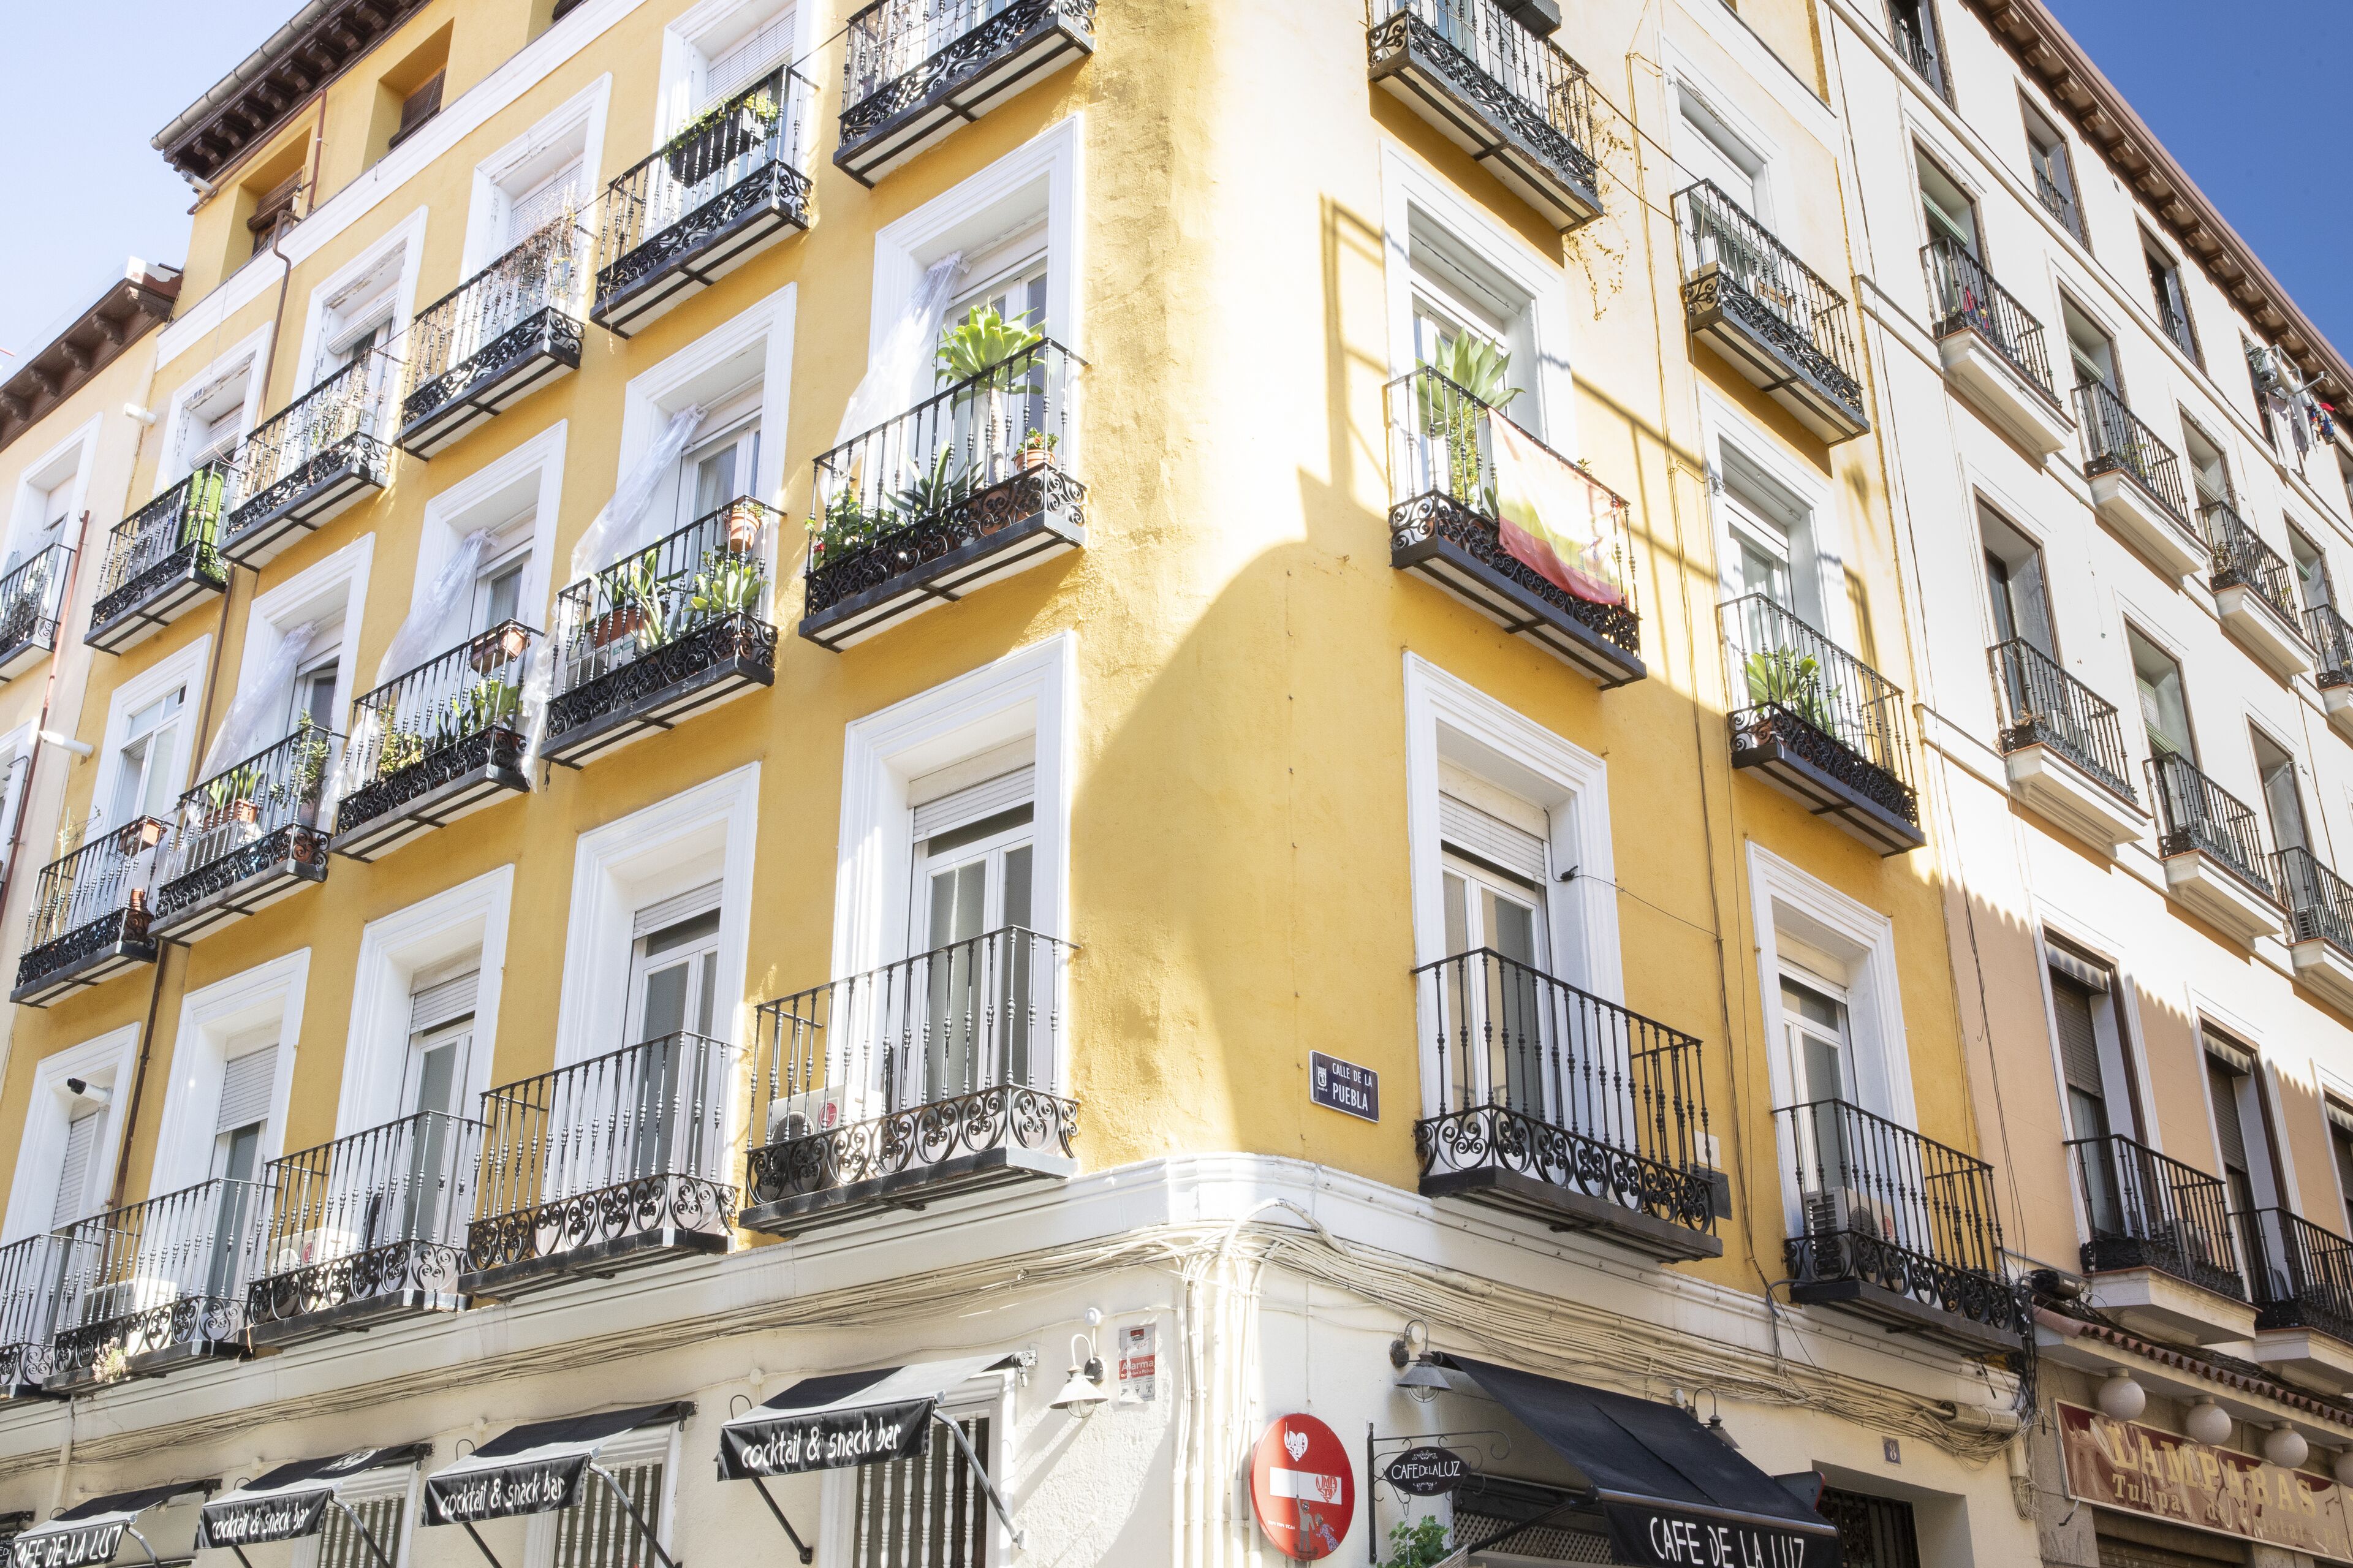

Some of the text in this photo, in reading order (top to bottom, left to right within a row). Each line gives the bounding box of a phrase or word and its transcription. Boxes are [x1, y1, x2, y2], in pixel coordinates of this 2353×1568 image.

[1333, 1062, 1373, 1088] CALLE DE LA
[1333, 1082, 1368, 1112] PUEBLA
[742, 1417, 901, 1468] cocktail & snack bar
[1890, 1442, 1897, 1461] 8
[1392, 1464, 1419, 1479] CAFE
[1428, 1464, 1438, 1475] LA
[1438, 1461, 1460, 1477] LUZ
[2105, 1426, 2316, 1517] LAMPARAS
[440, 1470, 565, 1516] cocktail & snack bar
[212, 1502, 309, 1540] cocktail & snack bar
[45, 1534, 68, 1567] DE
[67, 1532, 87, 1565] LA
[1650, 1517, 1805, 1568] CAFE DE LA LUZ
